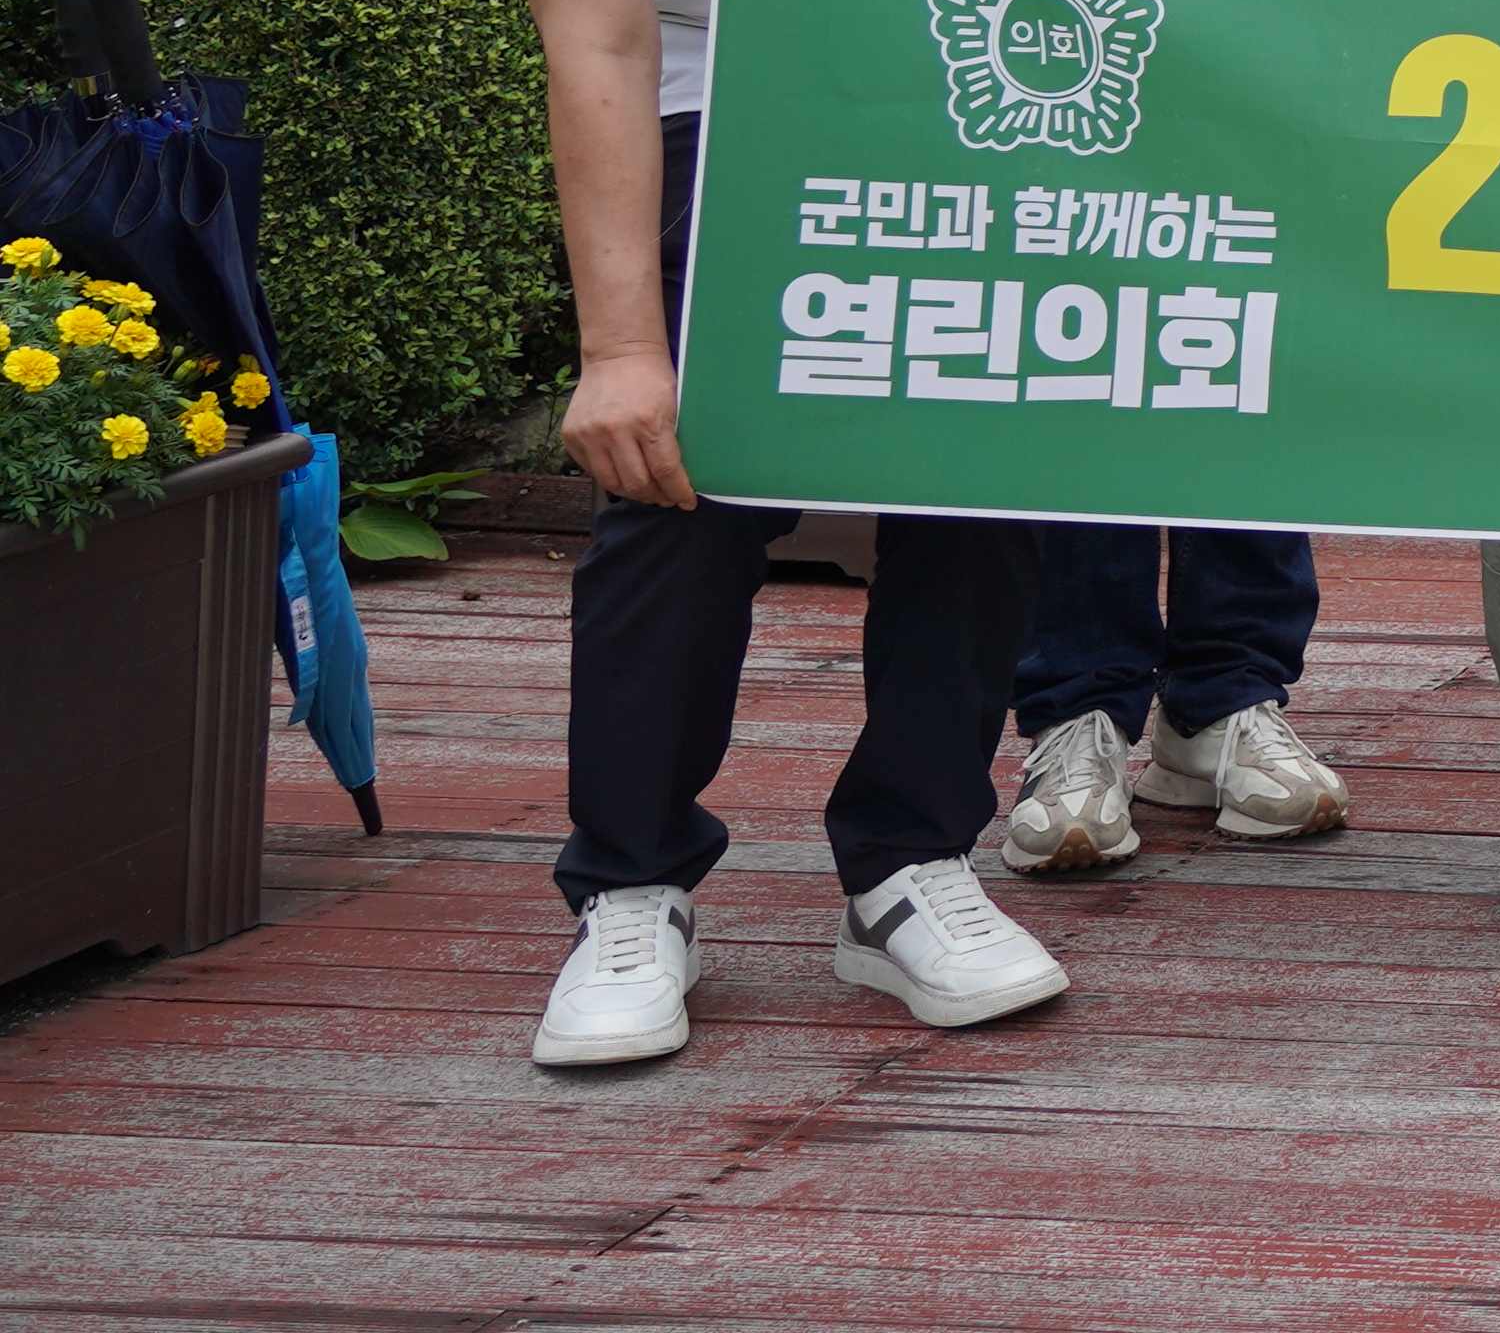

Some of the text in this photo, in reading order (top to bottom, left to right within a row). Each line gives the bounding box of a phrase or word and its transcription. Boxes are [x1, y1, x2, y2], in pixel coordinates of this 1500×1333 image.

[1007, 19, 1087, 69] 의회
[799, 177, 1277, 264] 군민과 함께하는
[778, 272, 1279, 414] 열린의회
